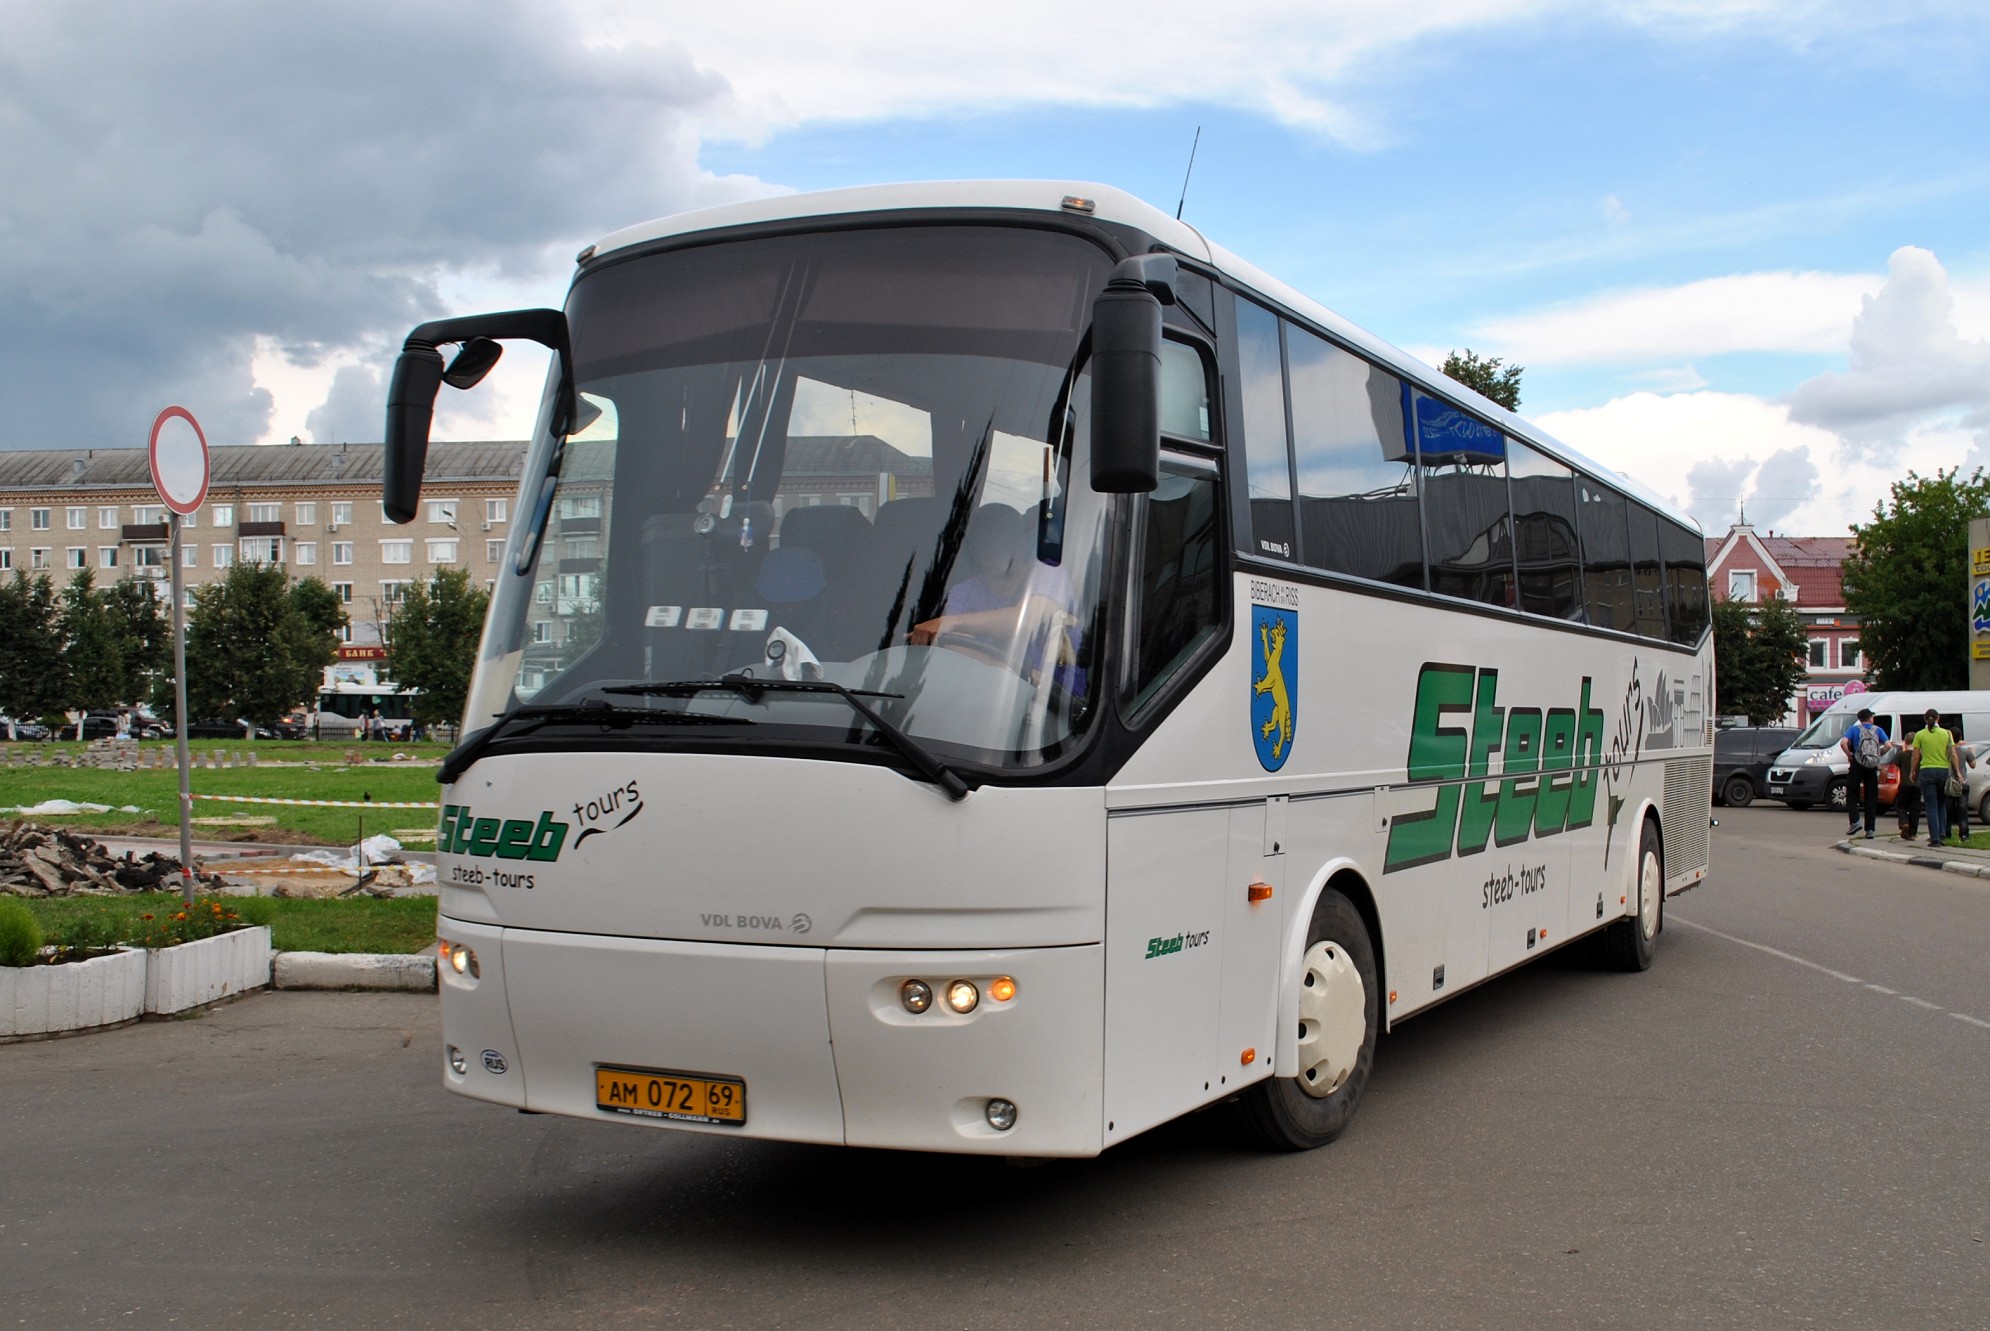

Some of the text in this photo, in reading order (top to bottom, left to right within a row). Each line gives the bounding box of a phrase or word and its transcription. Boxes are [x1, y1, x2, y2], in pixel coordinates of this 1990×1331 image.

[1251, 580, 1280, 603] BIBERACH
[1286, 586, 1299, 606] RISS
[345, 649, 375, 658] БАНК
[1810, 685, 1843, 700] cafe
[1382, 655, 1643, 876] Steeb tours
[438, 779, 640, 863] Steeb tours
[452, 864, 535, 889] steeb-tours
[1482, 863, 1546, 910] steeb-tours
[700, 913, 783, 930] VDL BOVA
[1144, 930, 1210, 960] Steeb tours
[484, 1057, 505, 1070] RUS
[609, 1079, 733, 1111] AM 072 69
[711, 1106, 731, 1116] RUS
